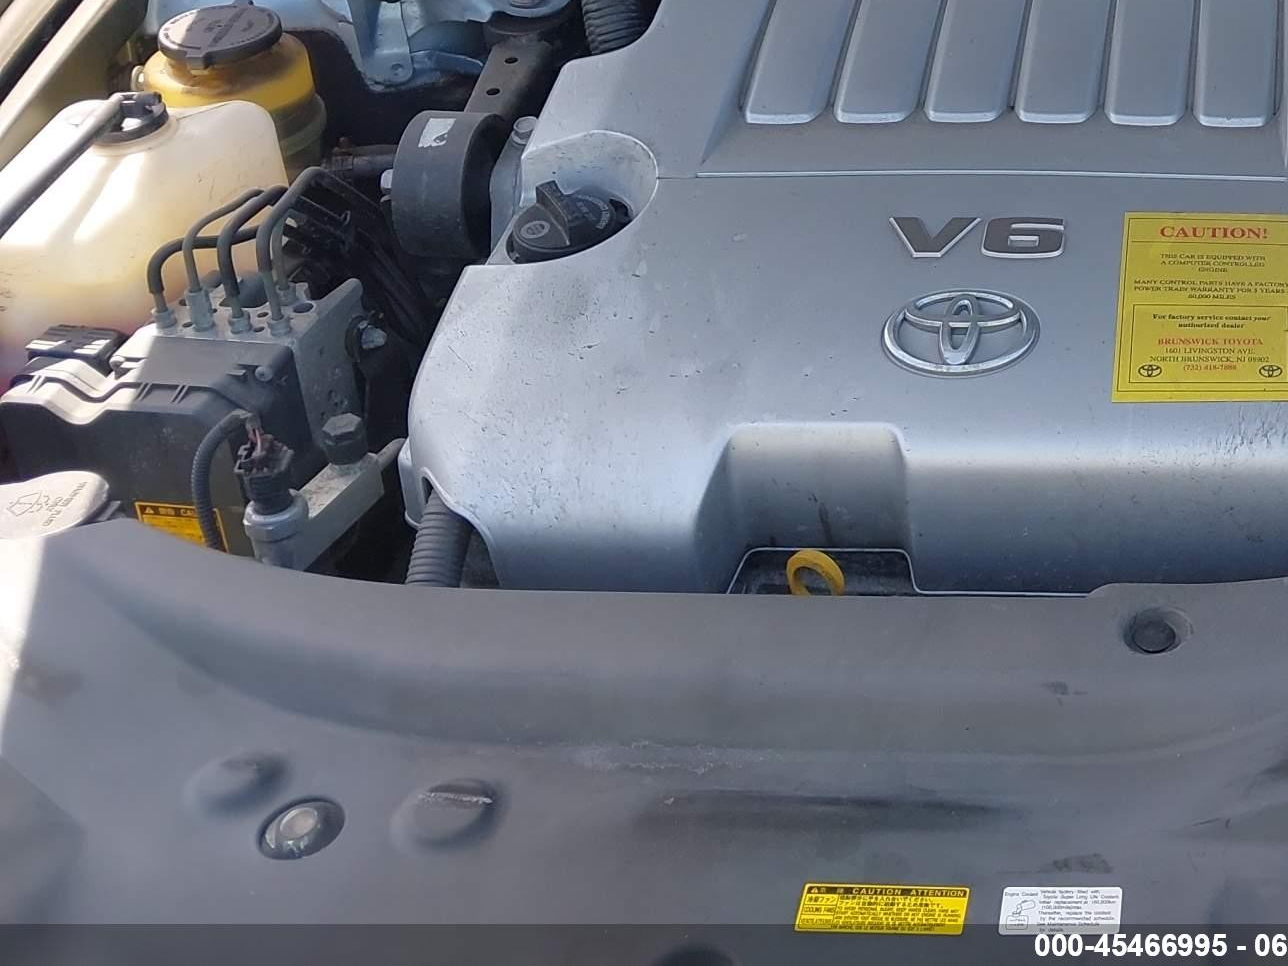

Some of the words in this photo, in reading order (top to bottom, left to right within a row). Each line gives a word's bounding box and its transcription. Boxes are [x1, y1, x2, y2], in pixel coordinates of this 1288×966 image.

[1159, 225, 1270, 240] CAUTION!
[888, 216, 1066, 259] V6
[1168, 313, 1196, 322] factory
[1157, 338, 1219, 346] BRUNSWICK
[1222, 338, 1264, 346] TOYOTA
[1149, 355, 1181, 363] NORTH
[852, 887, 903, 896] CAUTION
[909, 889, 965, 897] ATTENTION
